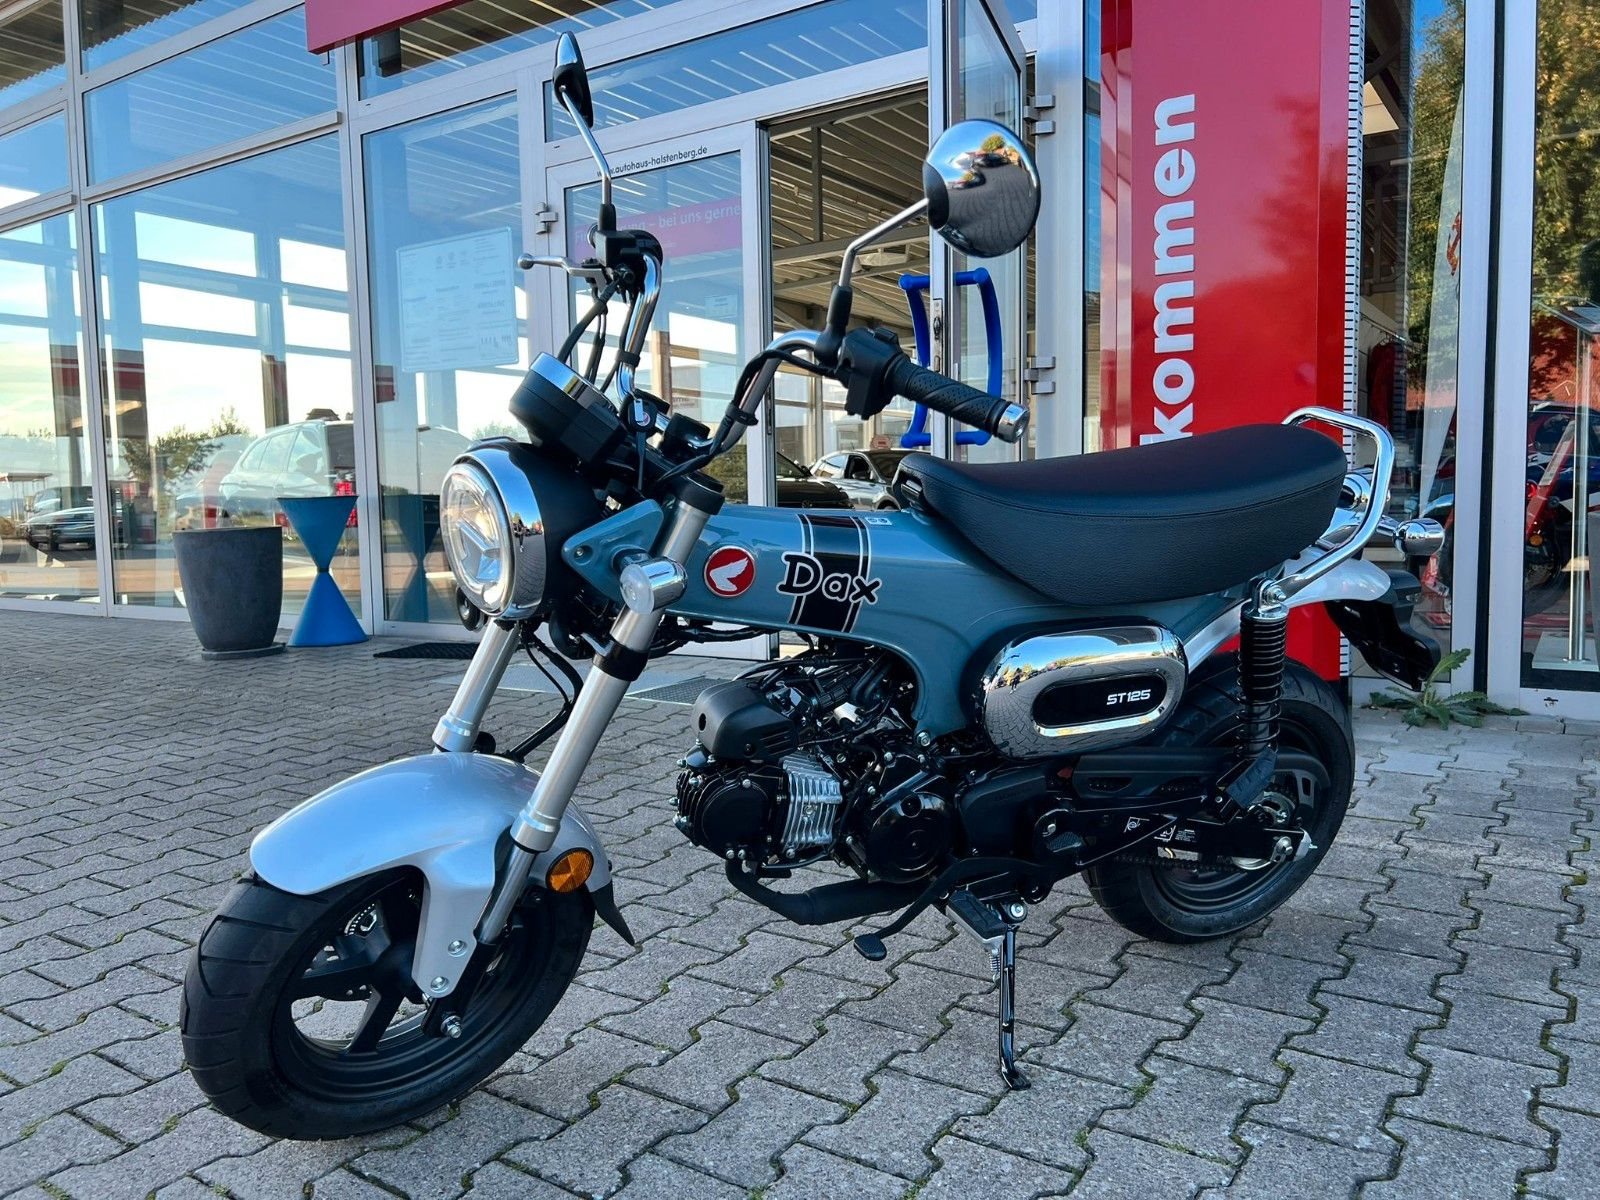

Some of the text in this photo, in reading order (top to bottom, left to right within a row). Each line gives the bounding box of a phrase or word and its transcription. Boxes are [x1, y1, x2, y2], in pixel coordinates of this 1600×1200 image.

[659, 213, 677, 228] bei
[680, 211, 702, 225] uns
[704, 205, 741, 224] gerne
[1140, 93, 1195, 445] kommen
[776, 551, 883, 605] Dax
[1106, 689, 1152, 706] ST125
